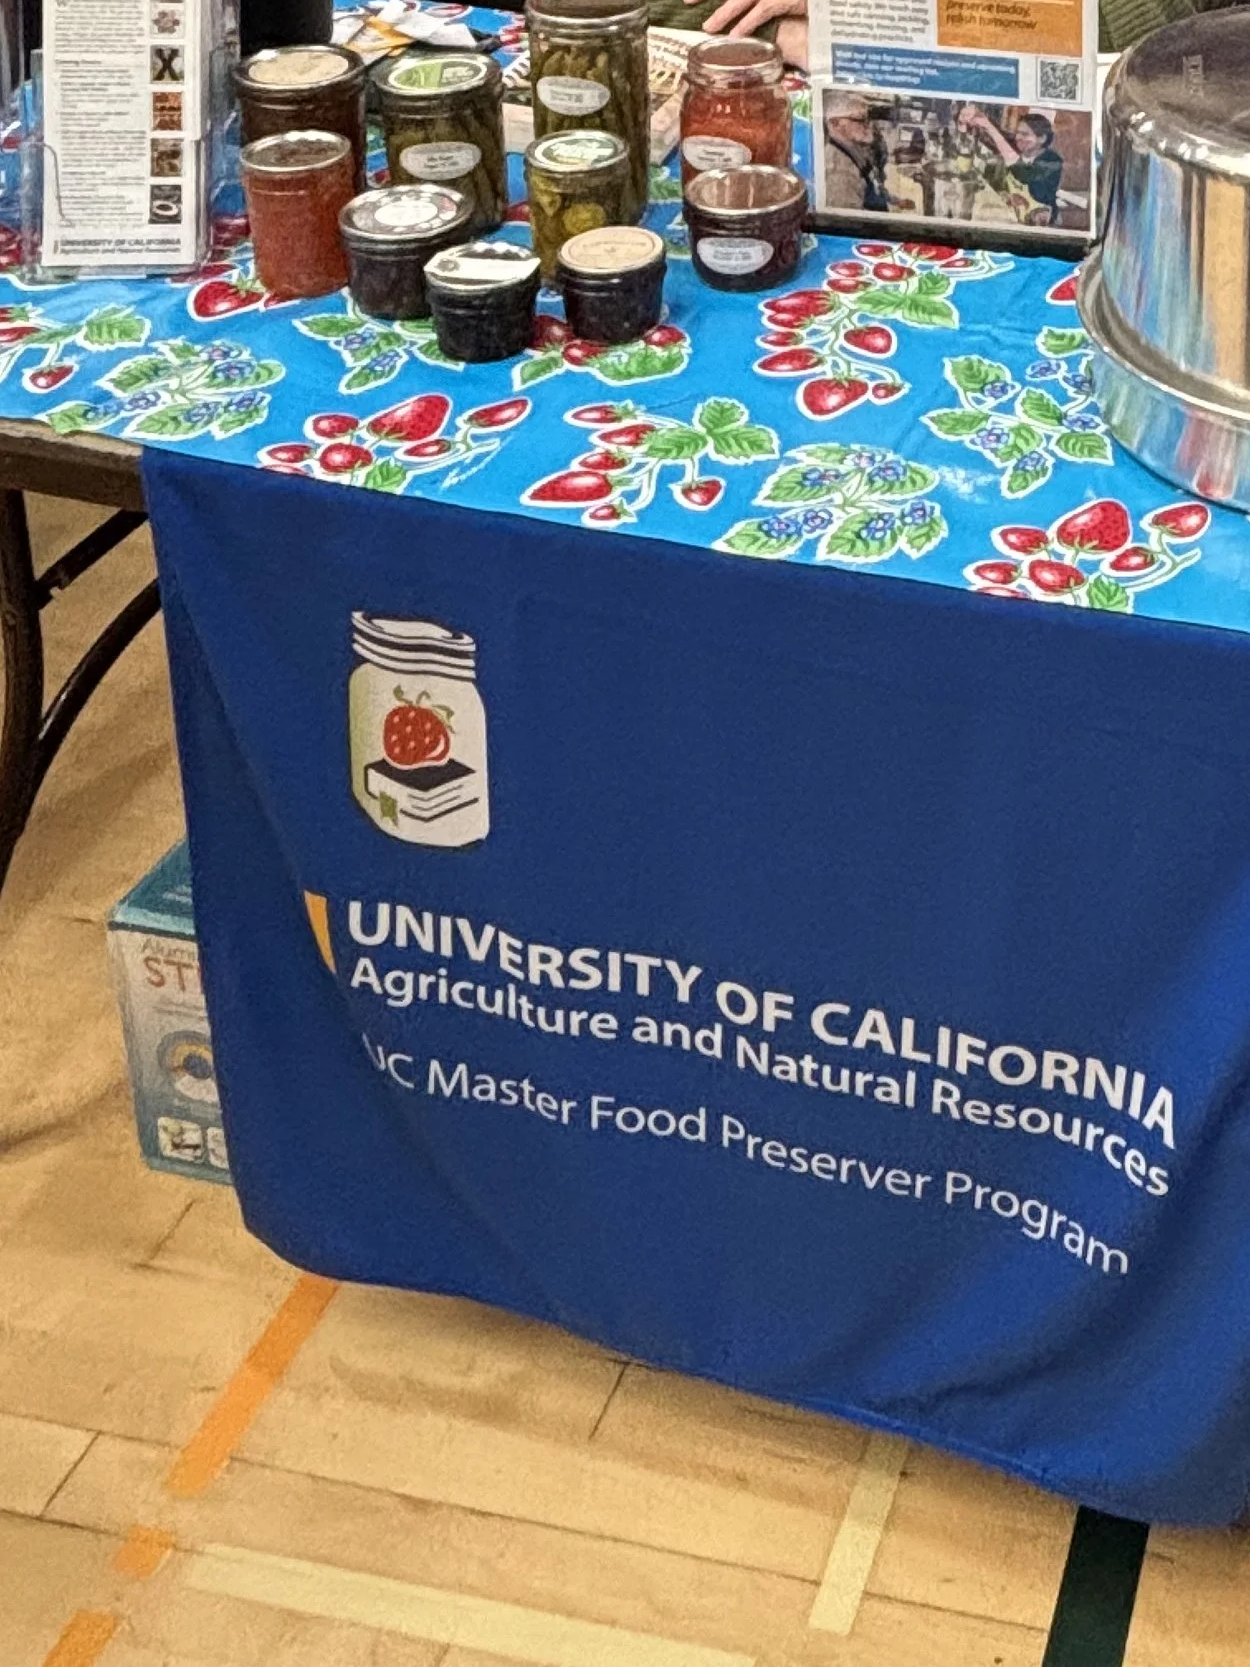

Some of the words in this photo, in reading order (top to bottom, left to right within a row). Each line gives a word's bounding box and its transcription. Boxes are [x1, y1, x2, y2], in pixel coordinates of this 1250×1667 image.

[348, 900, 703, 1004] UNIVERSITY
[715, 981, 795, 1033] OF
[810, 1001, 1175, 1150] CALIFORNIA
[350, 956, 618, 1040] Agriculture
[630, 1016, 723, 1060] and
[736, 1035, 916, 1109] Natural
[932, 1078, 1169, 1197] Resources
[427, 1058, 577, 1125] Master
[590, 1095, 706, 1143] Food
[721, 1114, 932, 1199] Preserver
[944, 1170, 1130, 1276] Program
